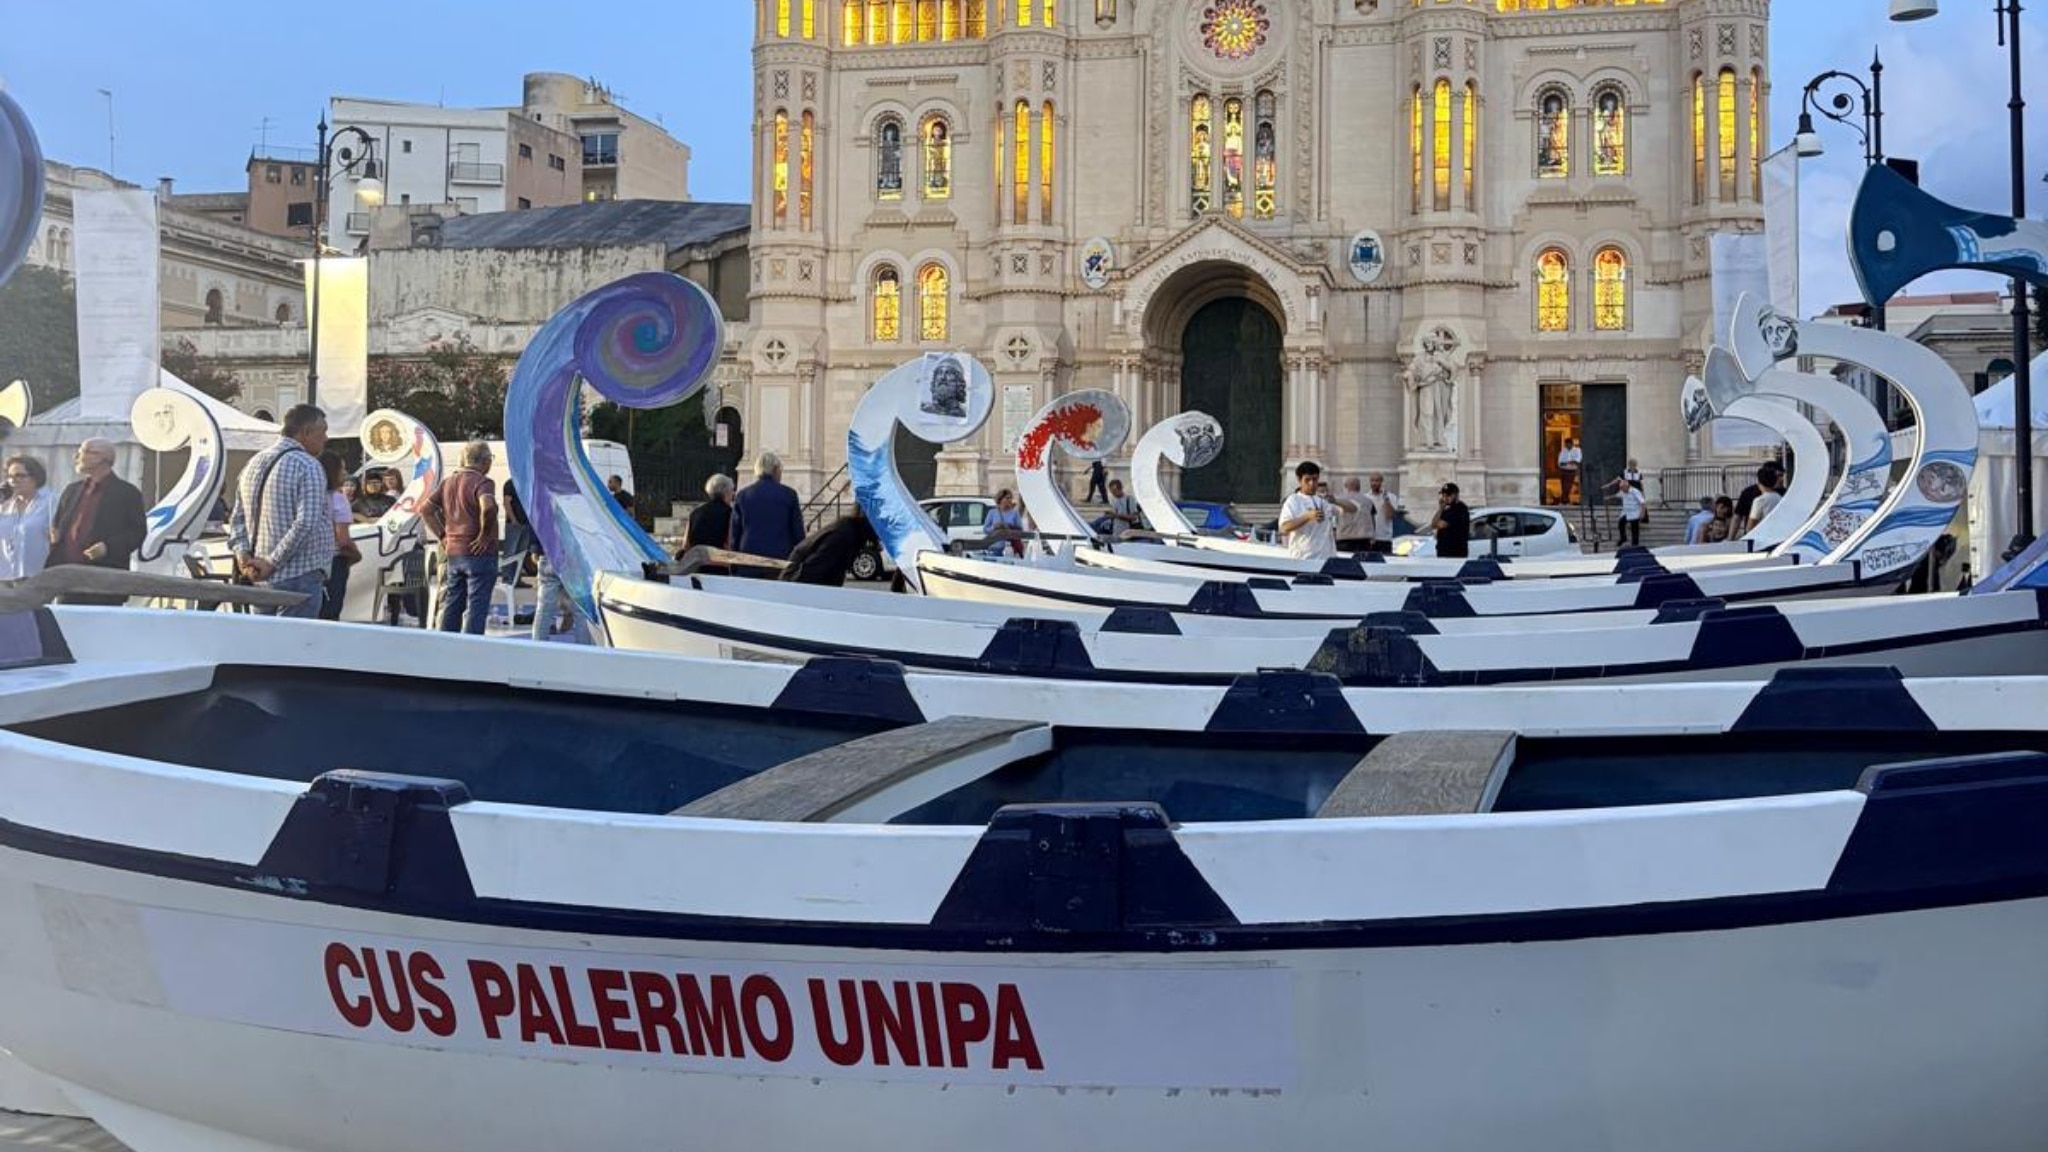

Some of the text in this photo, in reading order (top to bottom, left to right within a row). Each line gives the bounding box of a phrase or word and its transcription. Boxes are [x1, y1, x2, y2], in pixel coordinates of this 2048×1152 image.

[324, 942, 1045, 1071] CUS PALERMO UNIPA
